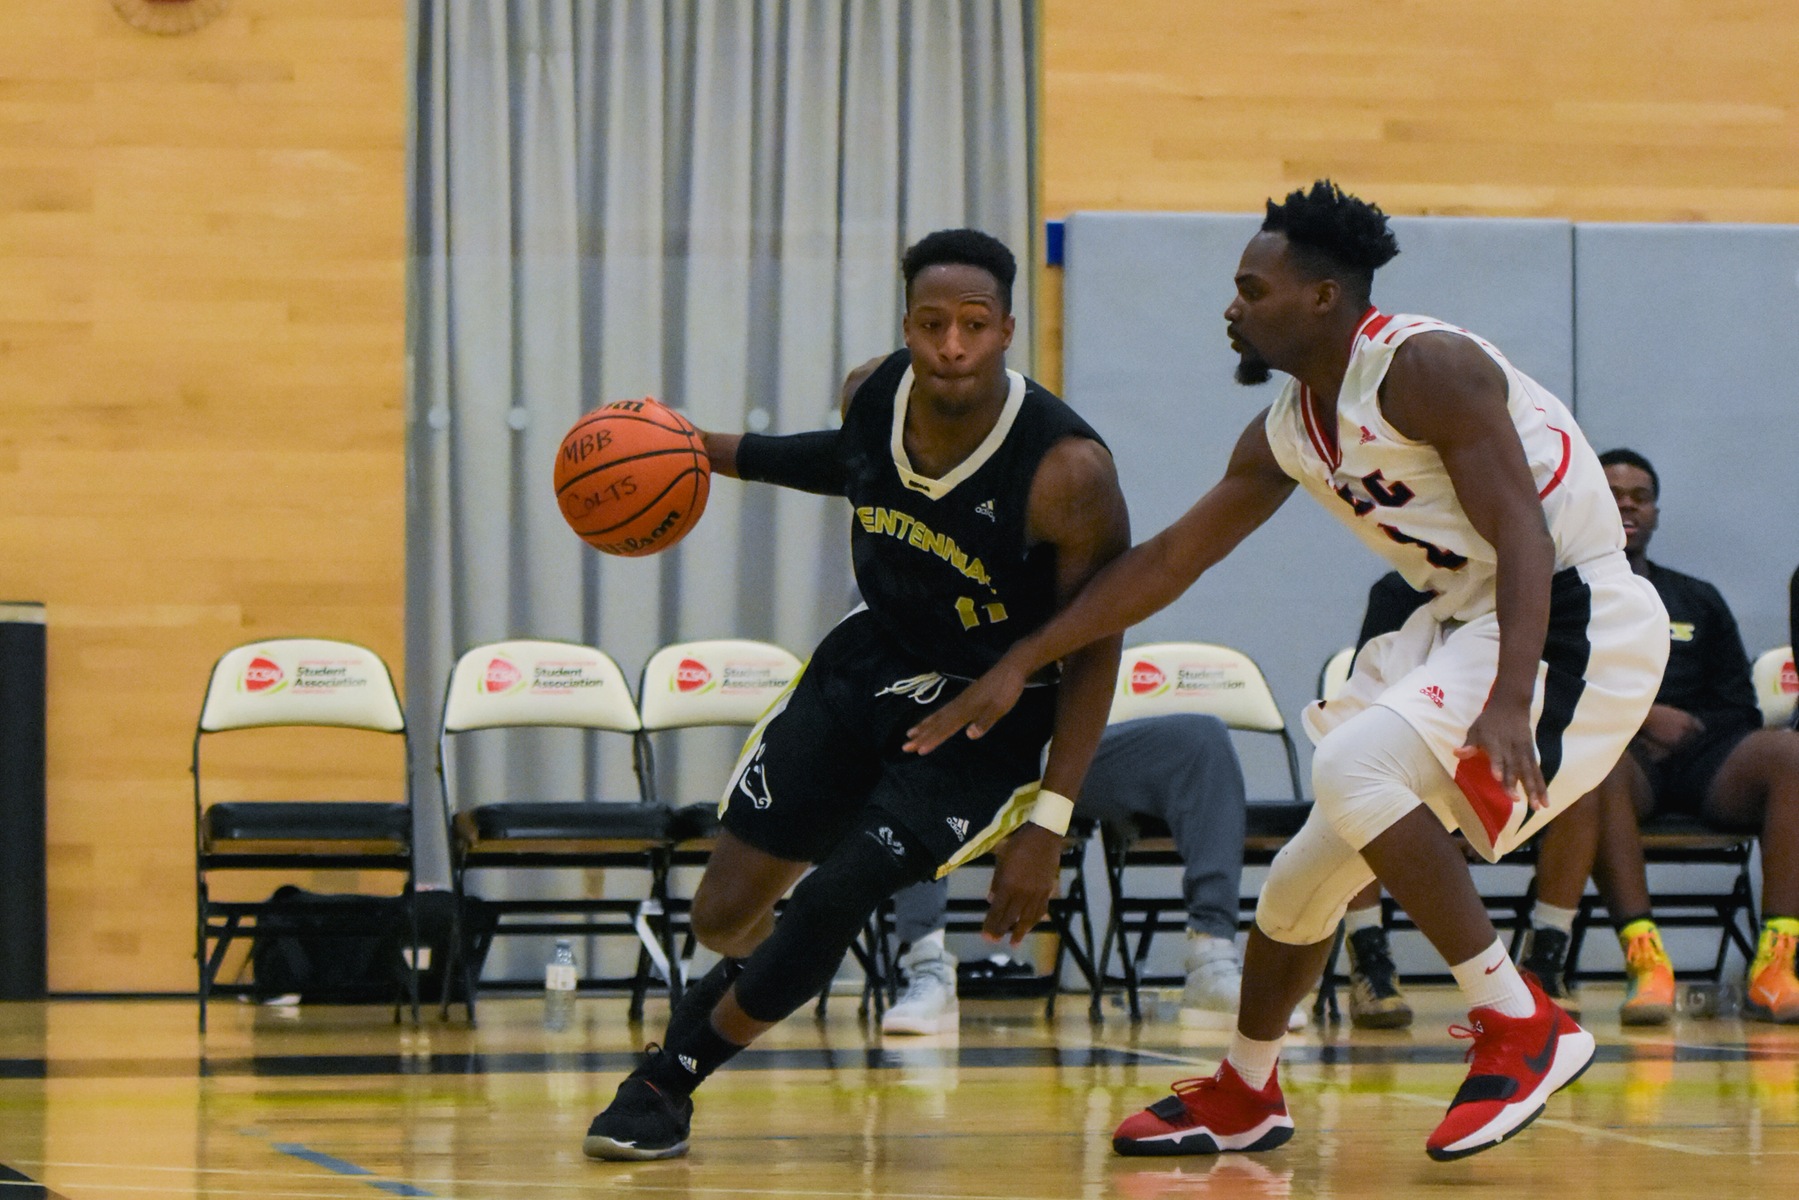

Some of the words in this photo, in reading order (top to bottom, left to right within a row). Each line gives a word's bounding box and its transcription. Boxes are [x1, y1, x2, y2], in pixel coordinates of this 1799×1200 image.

[562, 430, 613, 472] MBB
[856, 506, 994, 590] ENTENNIA
[297, 666, 346, 677] Student
[534, 667, 582, 678] Student
[723, 667, 770, 678] Student
[1178, 669, 1224, 681] Student
[294, 677, 367, 688] Association
[532, 678, 603, 689] Association
[1176, 680, 1246, 690] Association
